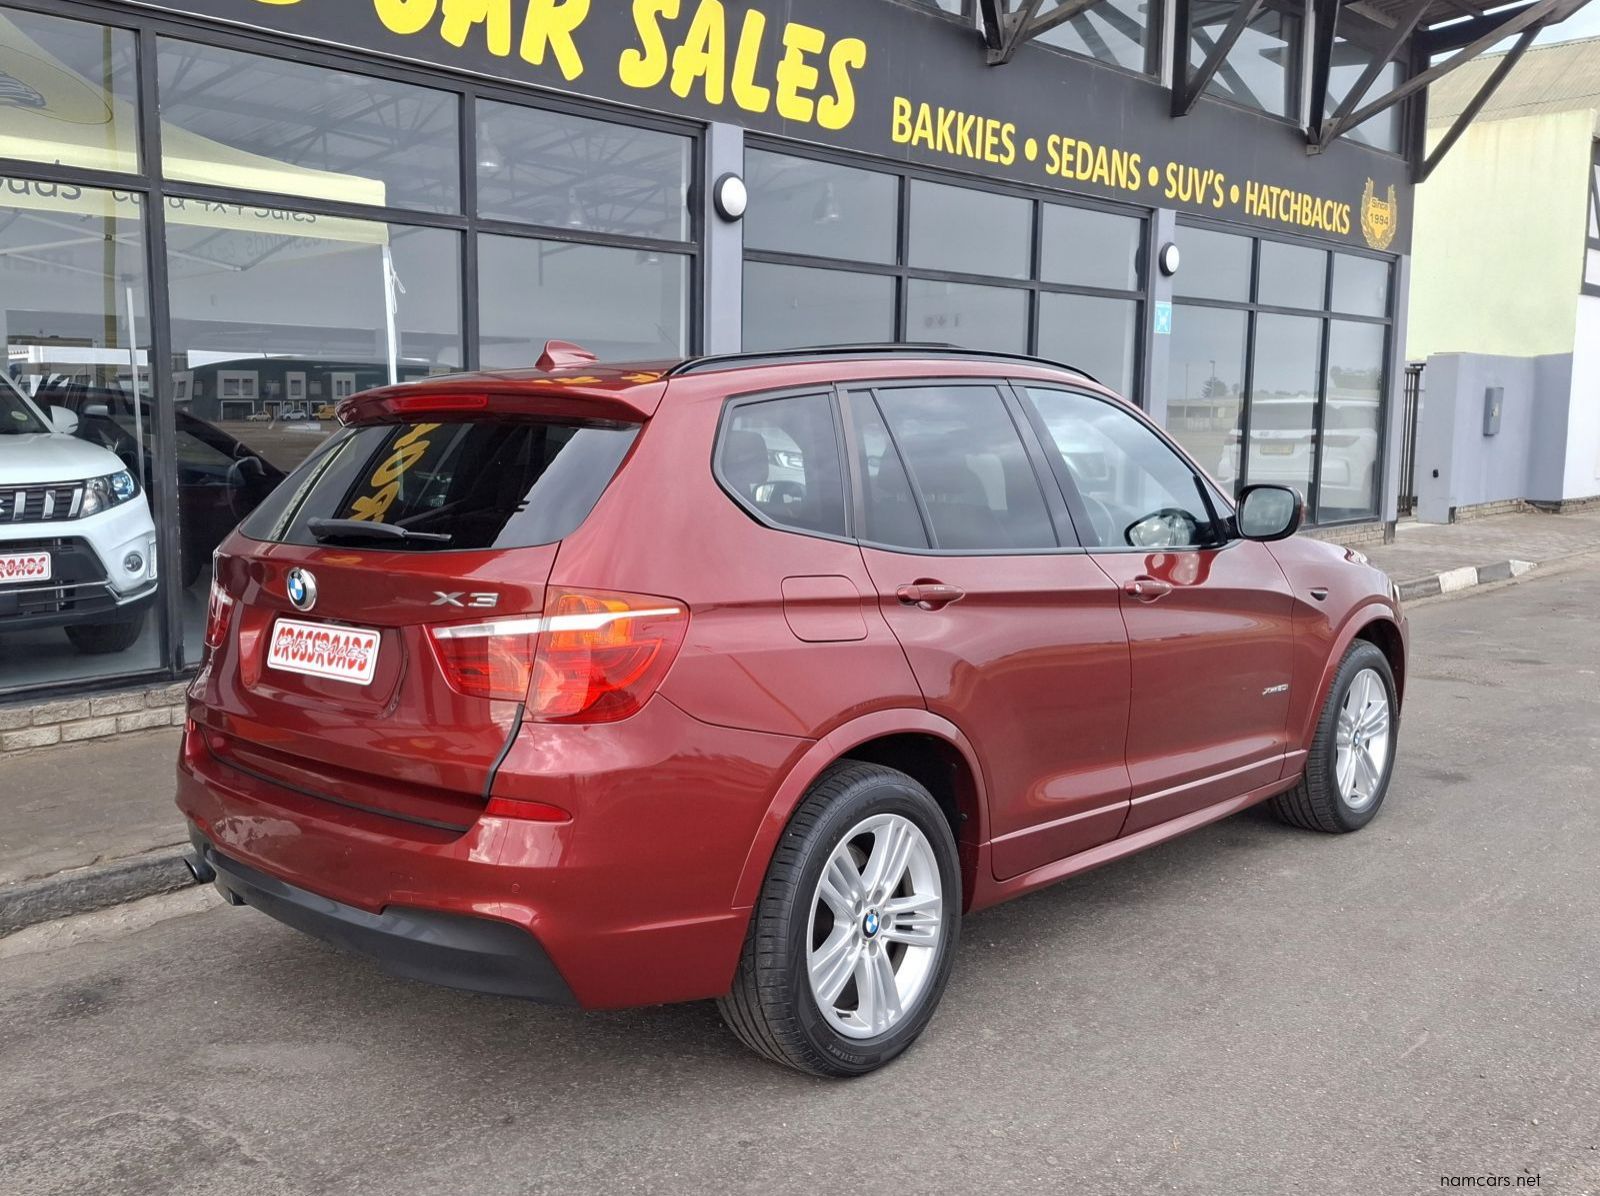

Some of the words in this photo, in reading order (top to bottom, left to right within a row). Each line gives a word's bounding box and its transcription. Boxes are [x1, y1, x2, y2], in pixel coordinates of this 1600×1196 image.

[619, 0, 867, 130] SALES
[891, 96, 1017, 165] BAKKIES
[1045, 133, 1141, 191] SEDANS
[1164, 161, 1225, 209] SUV'S
[1244, 181, 1350, 235] HATCHBACKS
[1370, 212, 1389, 226] 1994
[430, 591, 499, 608] X3
[273, 626, 374, 672] CROSSROADS
